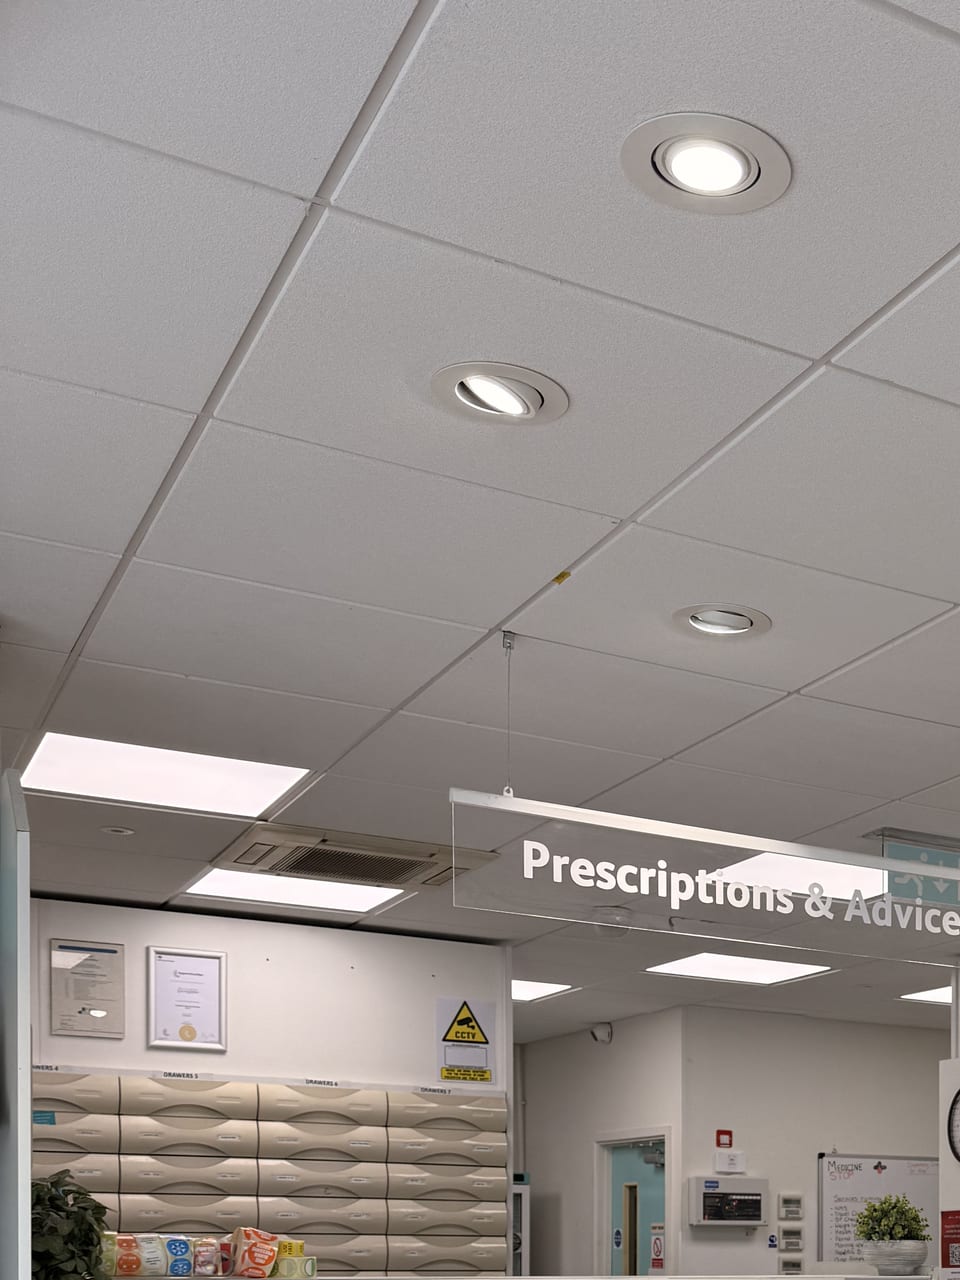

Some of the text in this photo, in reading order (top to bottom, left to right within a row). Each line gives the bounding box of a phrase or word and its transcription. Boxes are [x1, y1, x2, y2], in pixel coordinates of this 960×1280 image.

[522, 840, 960, 935] Prescriptions & Advice
[455, 1031, 476, 1039] CCTV
